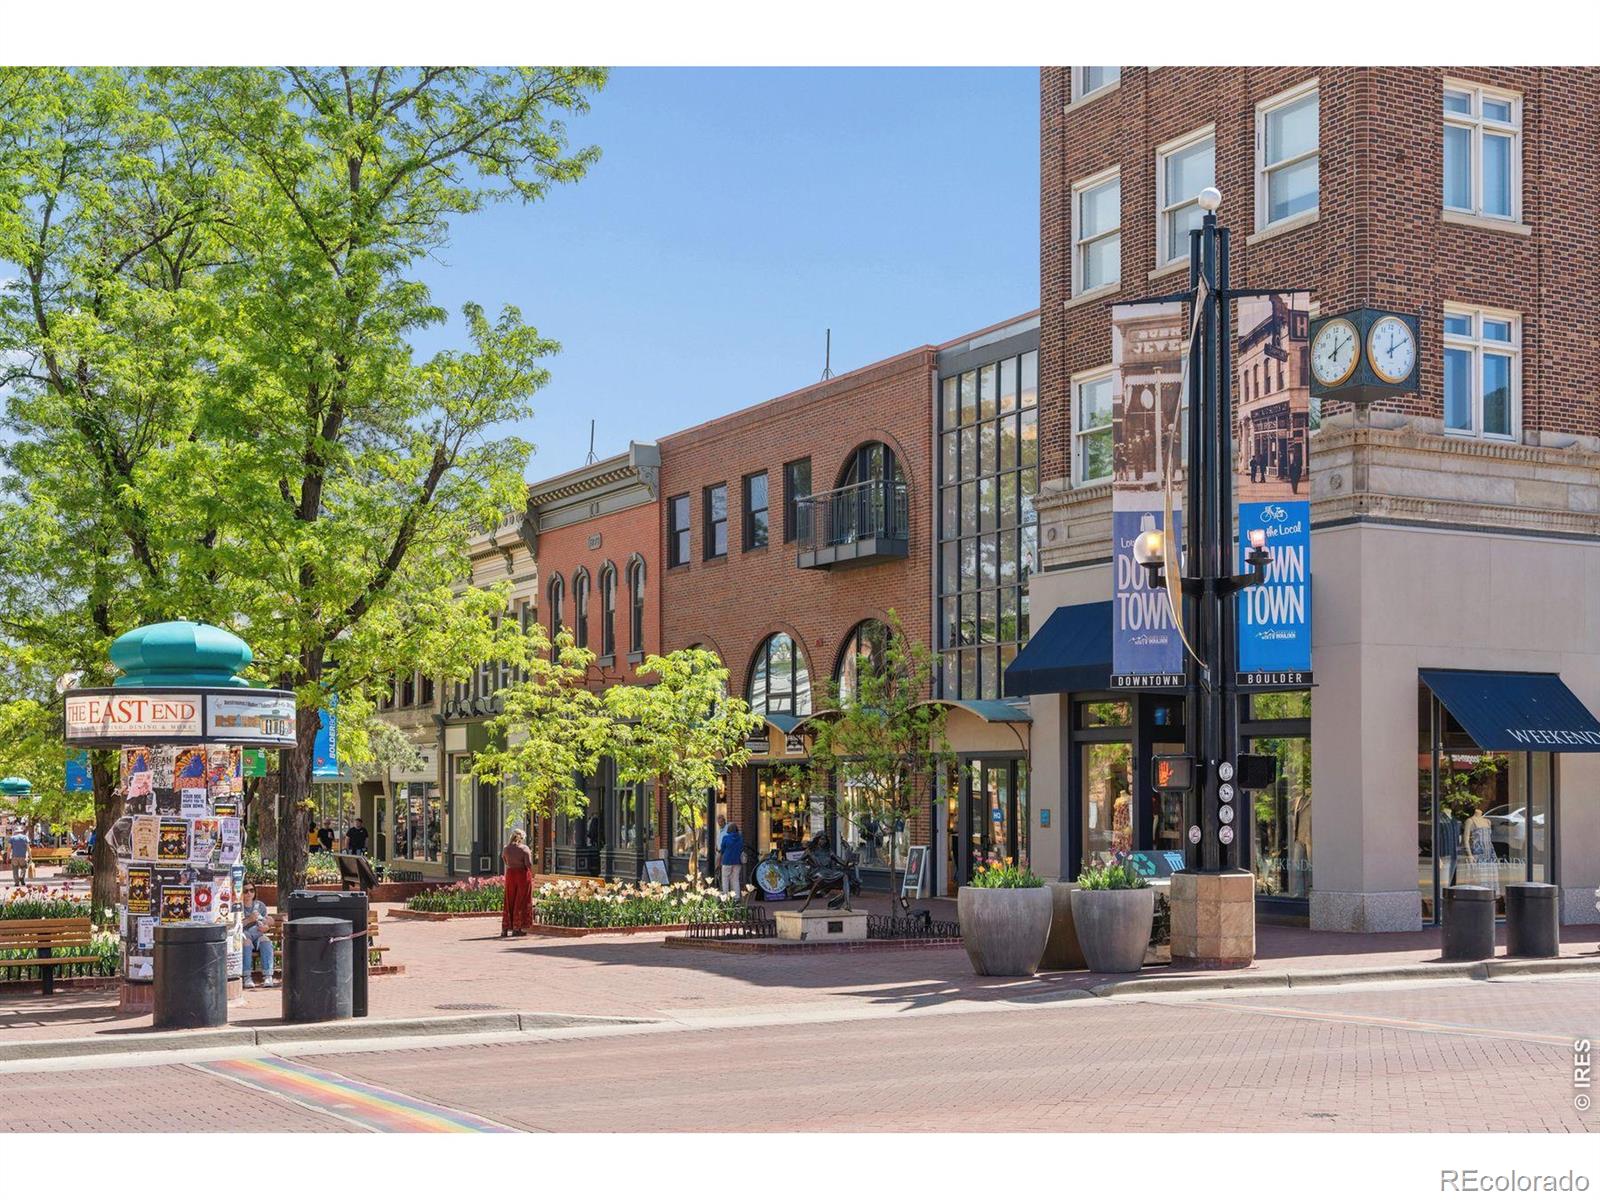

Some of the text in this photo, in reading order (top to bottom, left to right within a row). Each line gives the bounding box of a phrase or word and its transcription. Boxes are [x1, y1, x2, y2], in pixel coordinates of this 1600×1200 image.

[1279, 520, 1302, 536] Local
[1244, 586, 1304, 625] TOWN
[1118, 676, 1178, 686] DOWNTOWN
[1248, 673, 1302, 684] BOULDER
[68, 700, 196, 723] THE EAST END
[1506, 728, 1600, 744] WEEKEND
